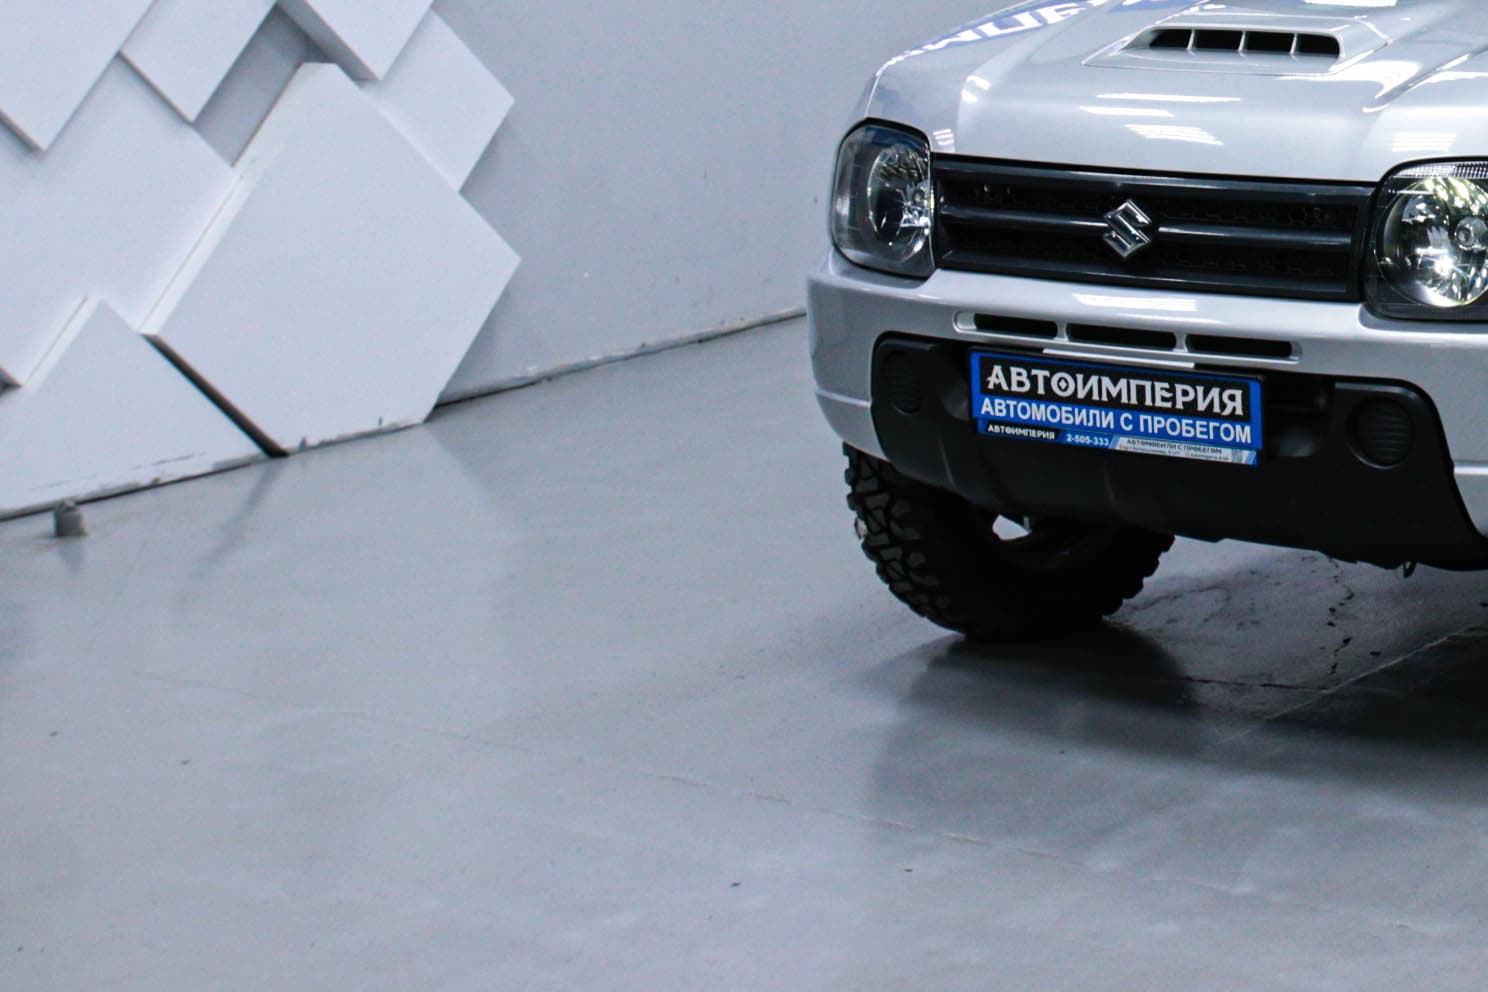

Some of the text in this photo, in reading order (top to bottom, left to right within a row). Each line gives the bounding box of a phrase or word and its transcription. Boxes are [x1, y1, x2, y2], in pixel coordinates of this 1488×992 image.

[986, 364, 1244, 416] АВТОИМПЕРИЯ
[981, 397, 1251, 443] АВТОМОБИЛИ С ПРОБЕГОМ
[988, 424, 1055, 440] АВТОИМПЕРИЯ
